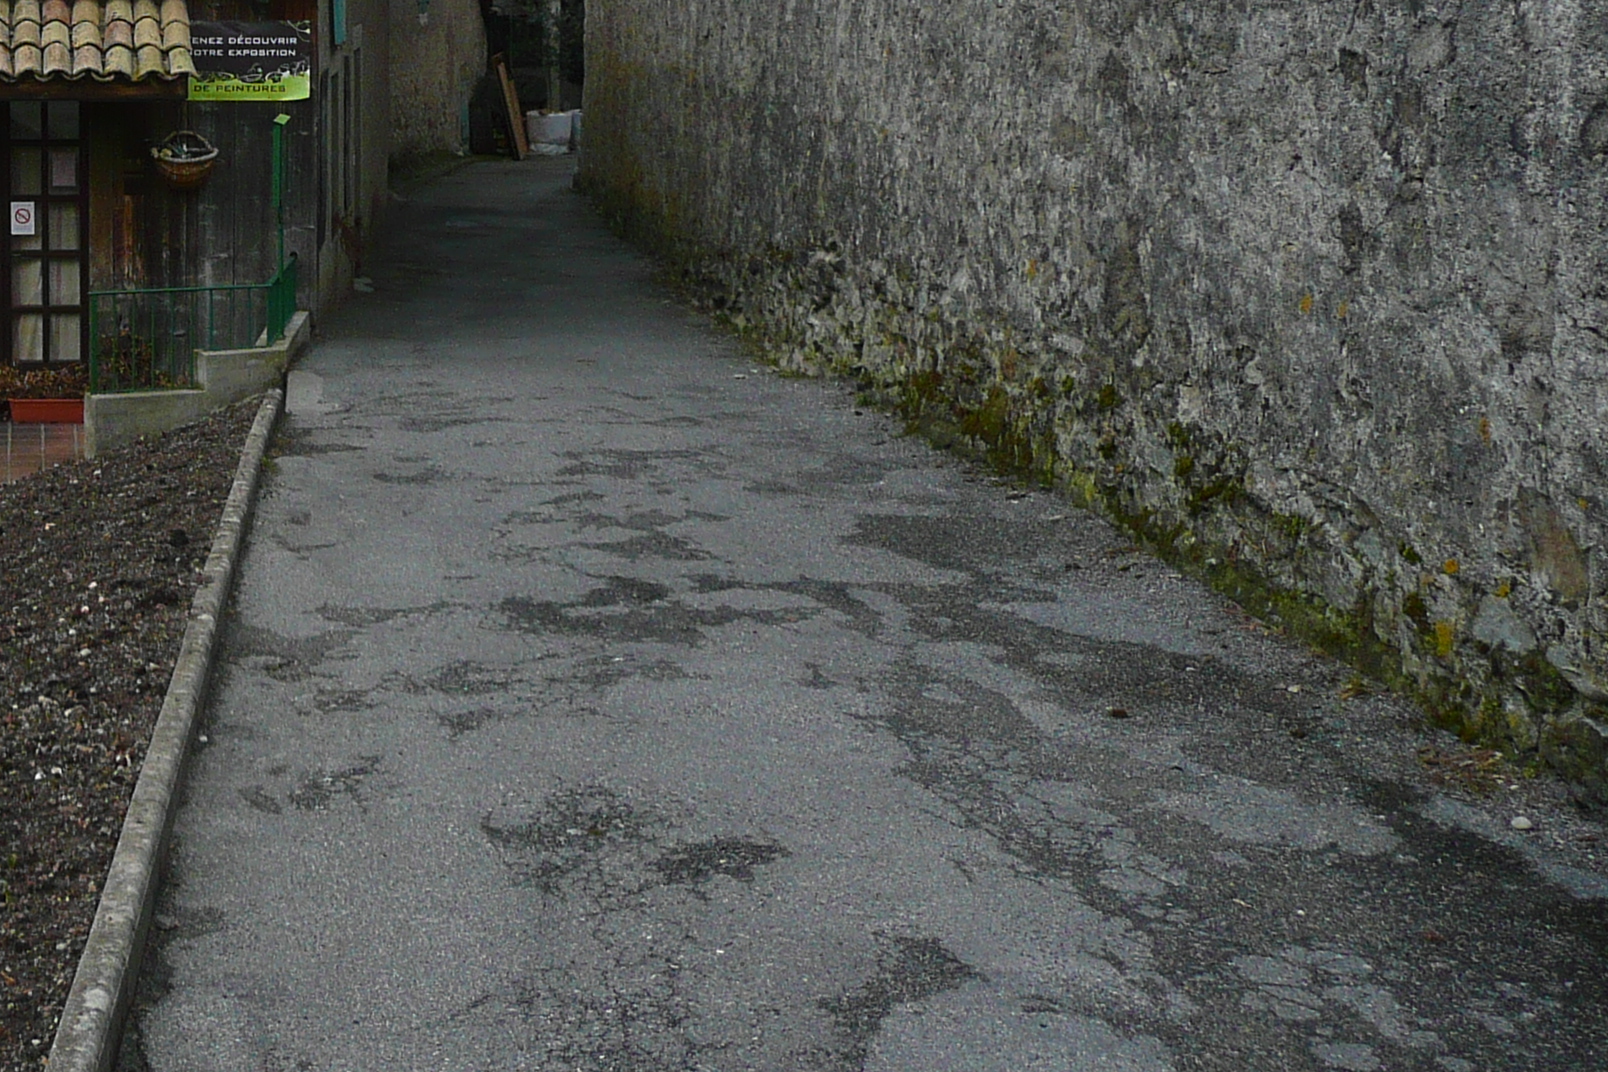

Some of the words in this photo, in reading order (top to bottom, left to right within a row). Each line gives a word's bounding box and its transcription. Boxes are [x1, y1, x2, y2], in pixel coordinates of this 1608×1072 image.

[191, 37, 224, 45] ENEZ
[228, 33, 298, 45] DÉCOUVRIR
[193, 85, 210, 93] DE
[216, 85, 286, 93] PEINTURES
